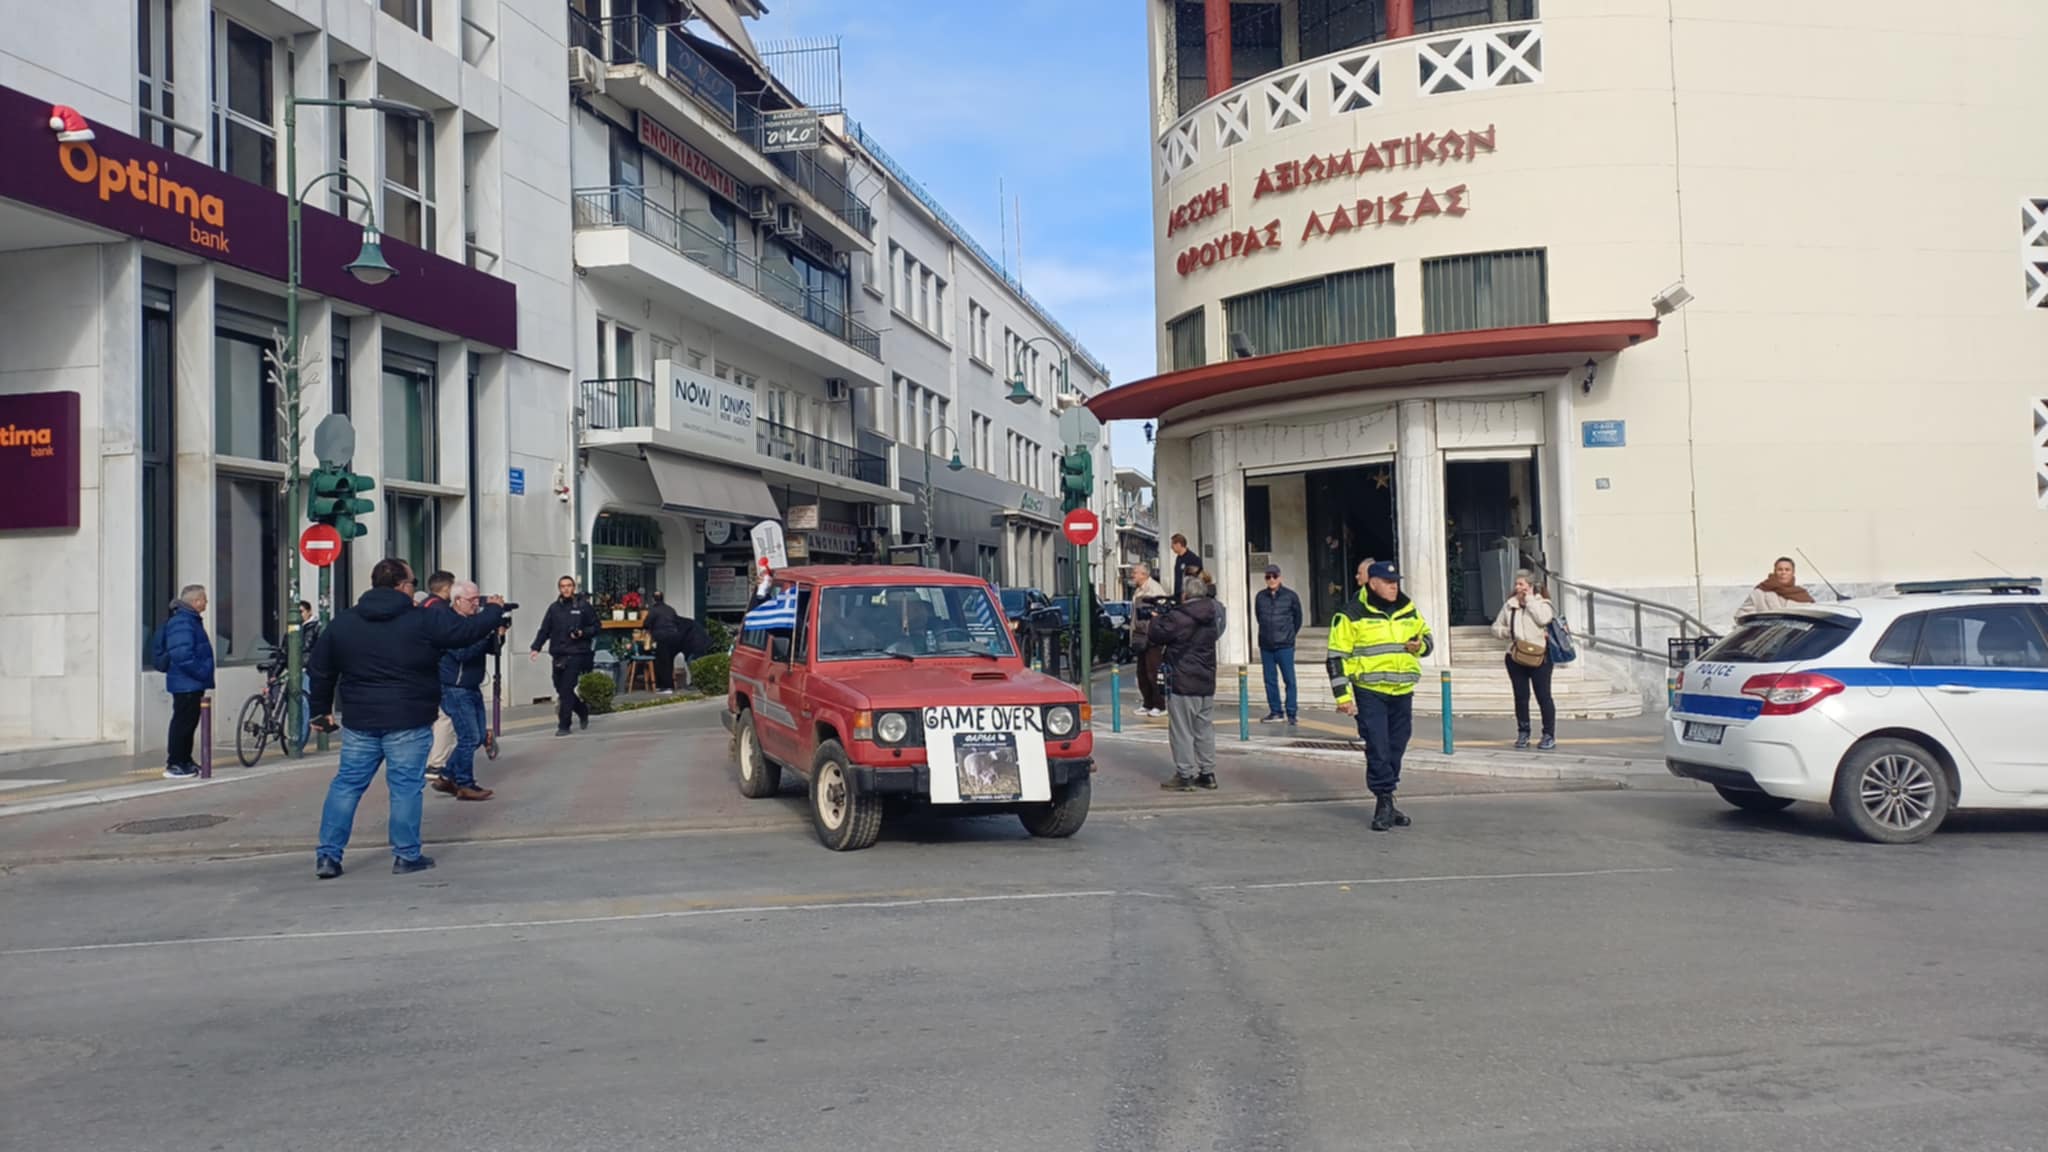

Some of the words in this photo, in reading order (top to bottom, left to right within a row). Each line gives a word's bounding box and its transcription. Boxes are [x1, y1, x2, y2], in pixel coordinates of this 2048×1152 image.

[641, 115, 735, 201] ΕΝΟΙΚΙΑΖΟΝΤΑΙ
[58, 141, 224, 228] Optima
[1167, 182, 1230, 239] ΛΕΣΧΗ
[1253, 123, 1496, 200] ΑΞΙΩΜΑΤΙΚΩΝ
[190, 220, 230, 253] bank
[1176, 218, 1282, 277] ΦΡΟΥΡΑΣ
[1301, 183, 1468, 242] ΛΑΡΙΣΑΣ
[675, 377, 712, 408] NOW
[0, 423, 51, 447] tima
[31, 445, 55, 457] bank
[1696, 663, 1736, 677] POLICE
[924, 706, 986, 731] GAME
[991, 706, 1044, 733] OVER
